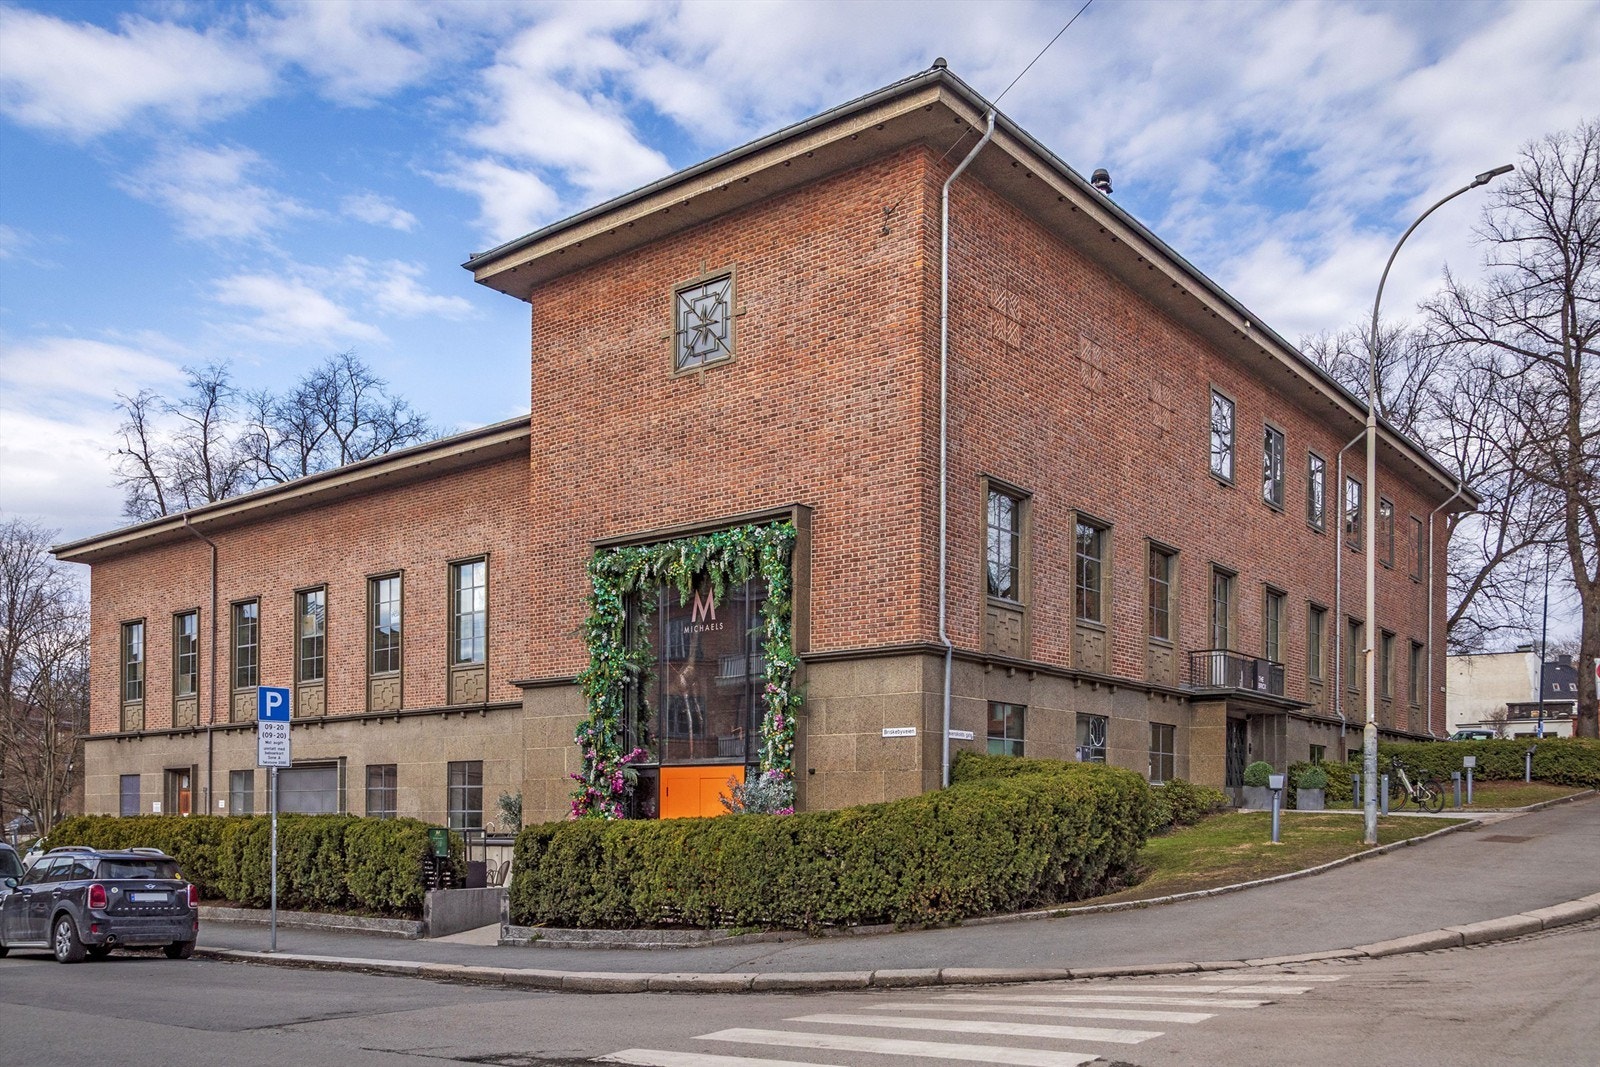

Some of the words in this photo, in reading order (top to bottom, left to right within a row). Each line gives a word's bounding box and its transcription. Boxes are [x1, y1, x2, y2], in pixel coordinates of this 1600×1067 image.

[691, 587, 716, 622] M
[683, 622, 724, 634] MICHAELS
[266, 691, 282, 716] P
[884, 728, 915, 736] Briskebyveien
